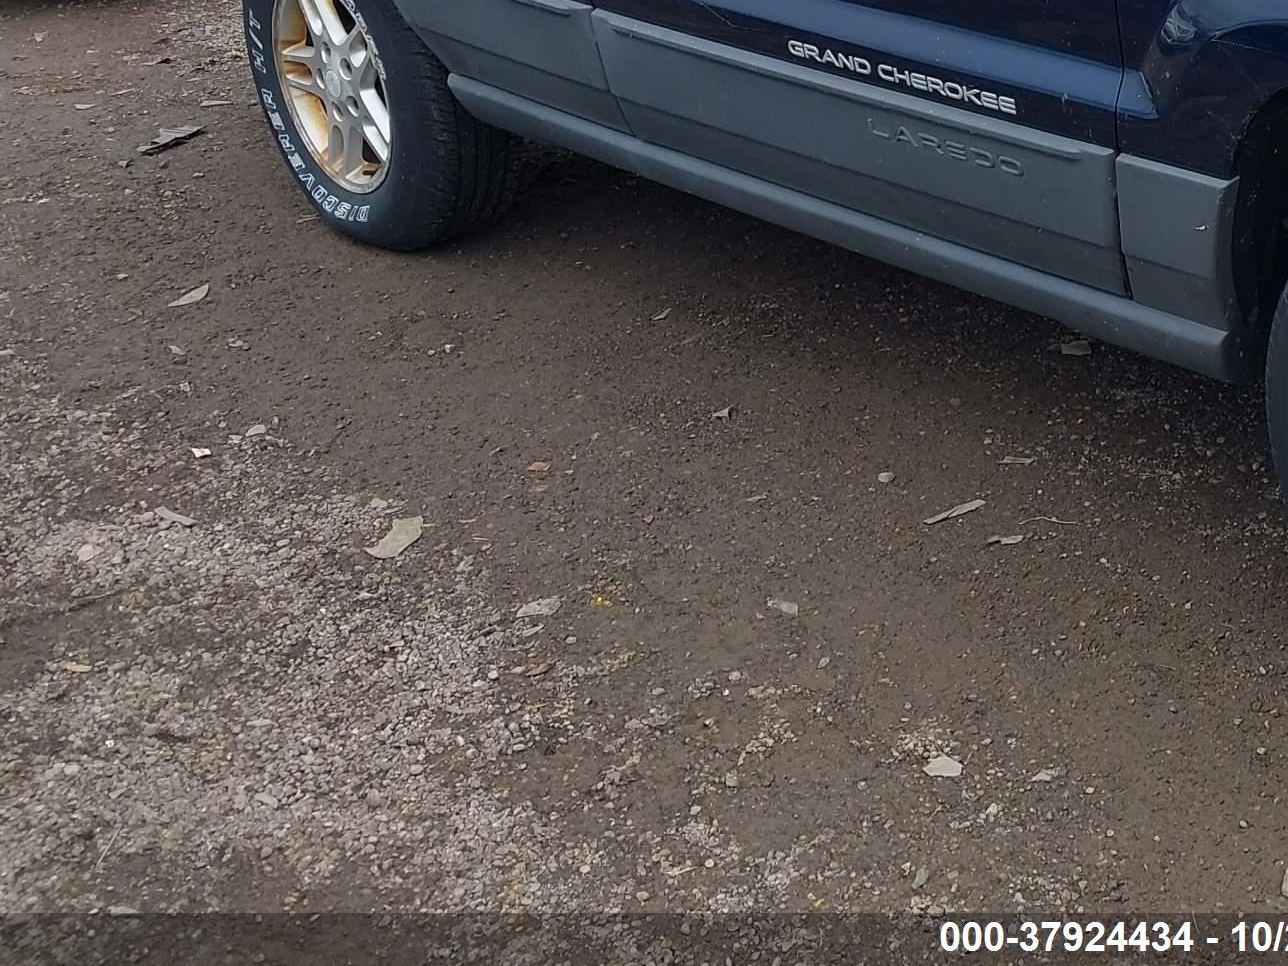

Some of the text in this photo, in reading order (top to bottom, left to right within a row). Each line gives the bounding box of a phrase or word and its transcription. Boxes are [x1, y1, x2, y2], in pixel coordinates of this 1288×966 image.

[787, 39, 1017, 115] GRAND CHEROKEE
[261, 88, 371, 222] DISCOVERER
[866, 117, 1025, 177] LAREDO
